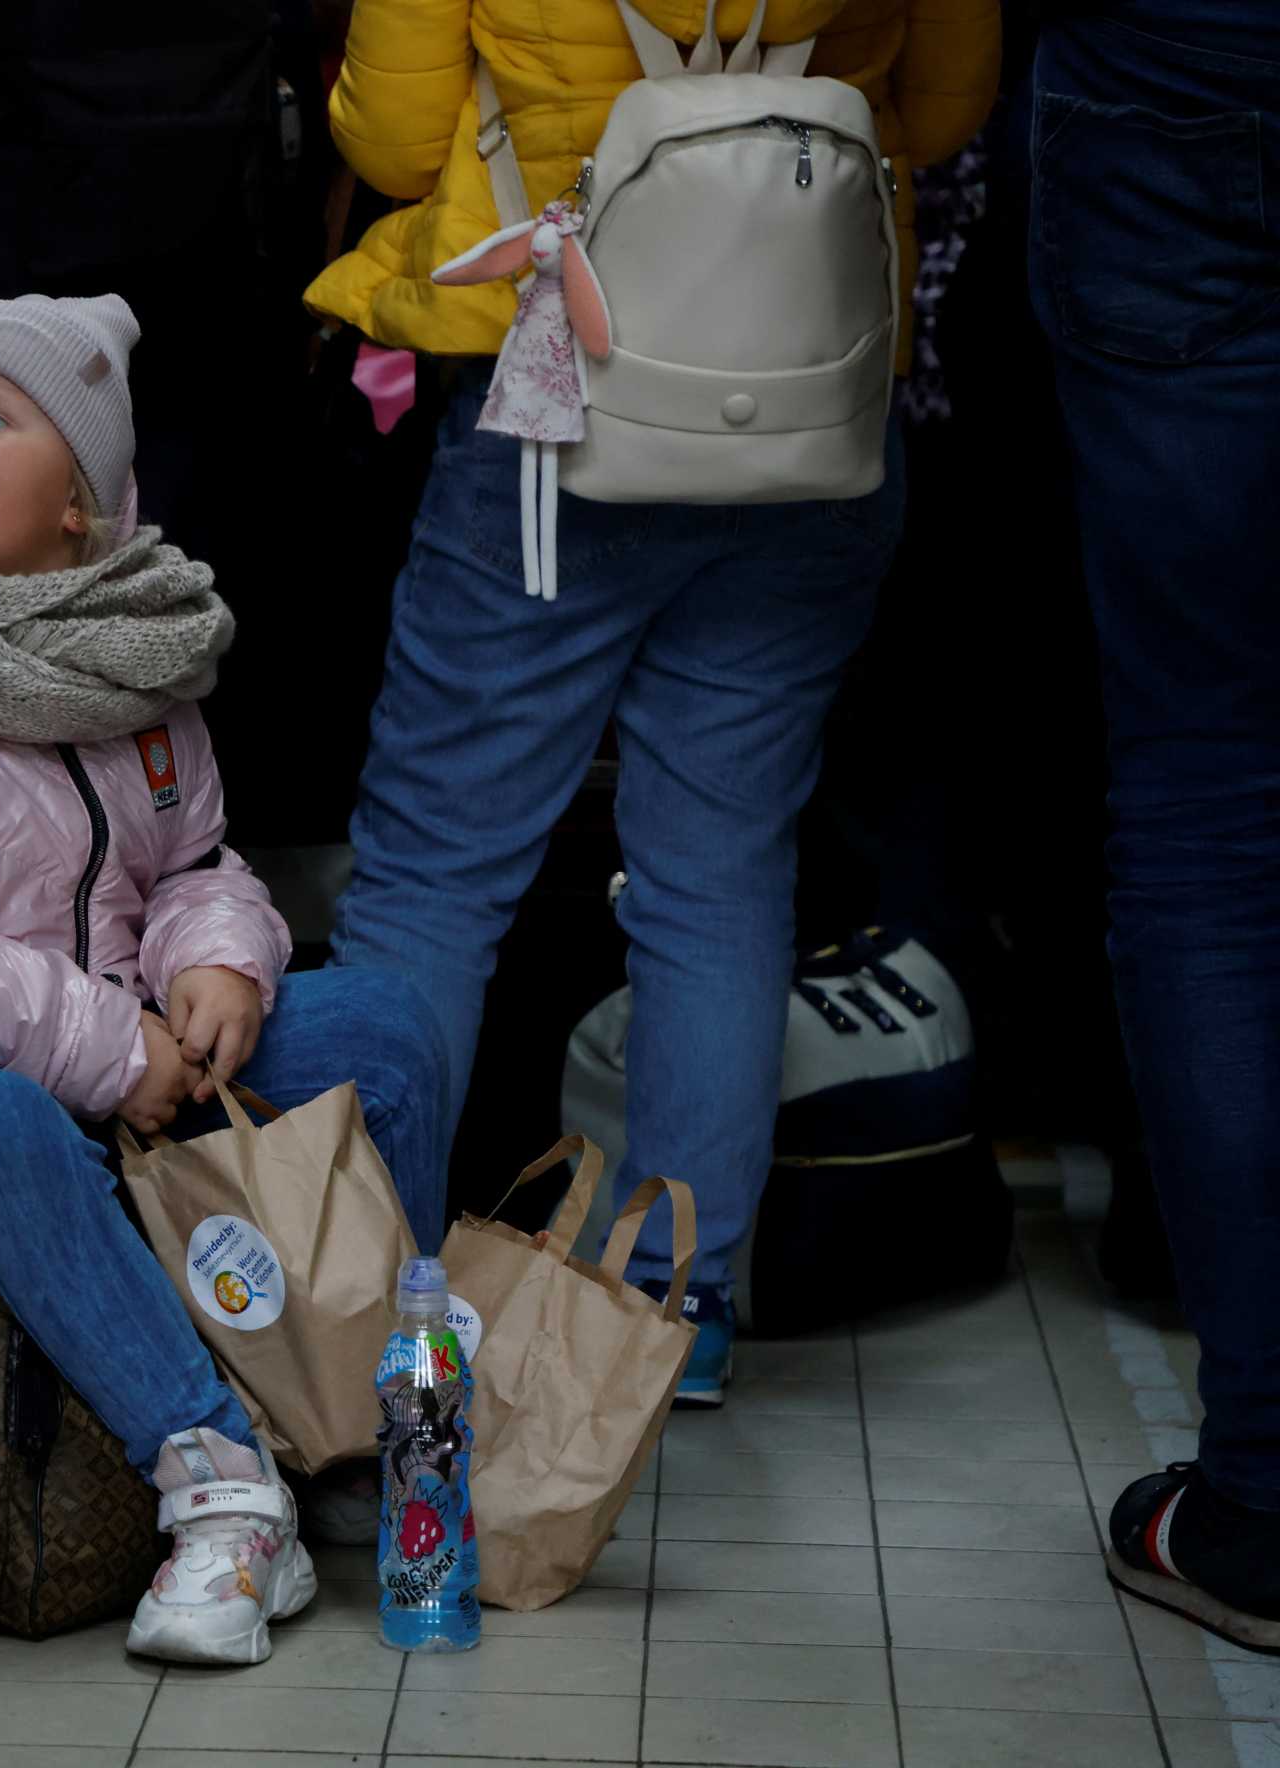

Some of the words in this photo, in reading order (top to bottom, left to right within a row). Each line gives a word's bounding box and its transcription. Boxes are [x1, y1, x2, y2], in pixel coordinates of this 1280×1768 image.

[192, 1232, 225, 1271] Provided
[223, 1221, 237, 1236] by:
[236, 1247, 258, 1270] World
[246, 1251, 269, 1279] Central
[254, 1261, 278, 1288] Kitchen
[455, 1313, 473, 1326] by:
